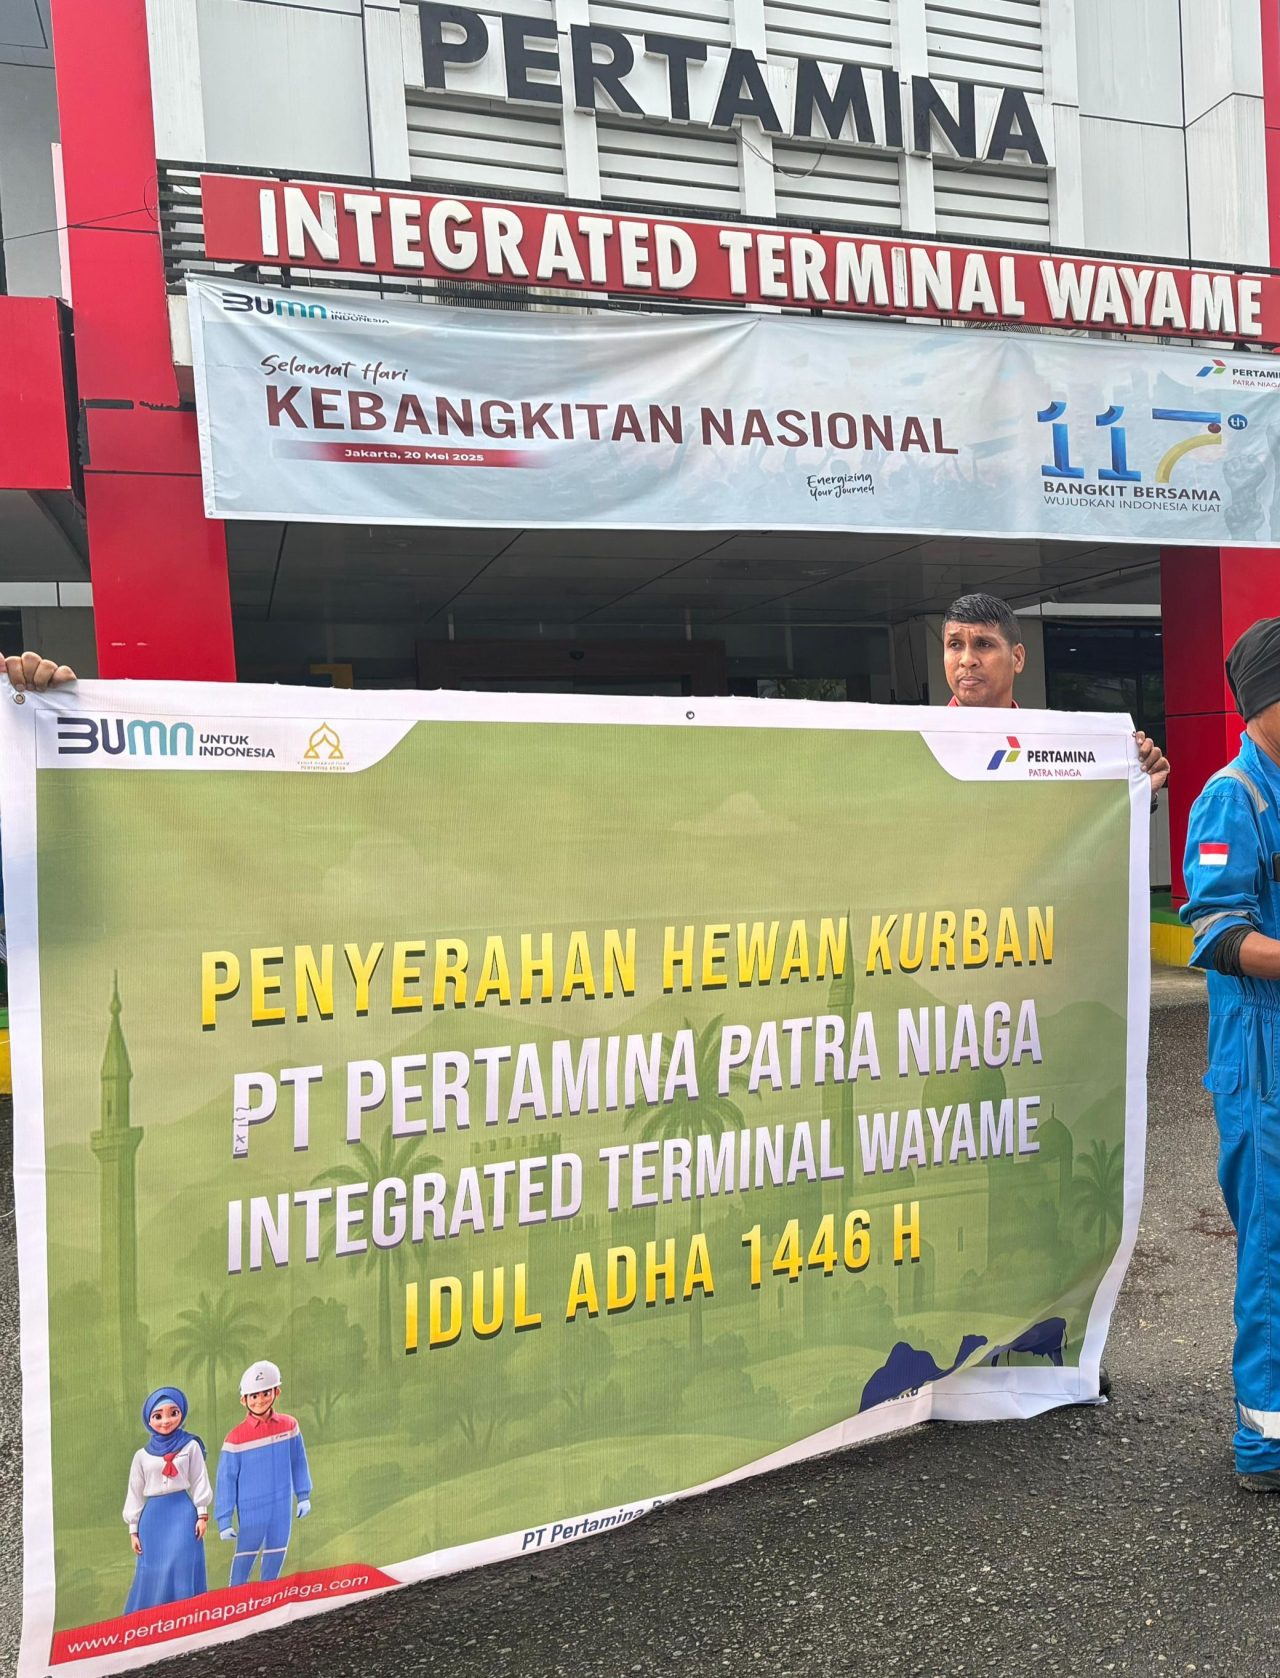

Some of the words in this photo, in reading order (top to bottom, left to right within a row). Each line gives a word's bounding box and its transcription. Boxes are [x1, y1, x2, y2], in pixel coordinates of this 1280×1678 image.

[419, 1, 1048, 165] PERTAMINA
[259, 186, 698, 291] INTEGRATED
[718, 229, 1026, 317] TERMINAL
[1039, 259, 1263, 336] WAYAME
[260, 354, 357, 379] Selamat
[361, 361, 409, 385] Hari
[1232, 378, 1255, 387] PATRA
[265, 384, 683, 444] KEBANGKITAN
[700, 406, 959, 455] NASIONAL
[344, 448, 401, 461] Jakarta,
[404, 450, 422, 460] 20
[452, 452, 485, 462] 2025
[806, 473, 873, 489] Energizing
[834, 485, 875, 499] Journey
[1044, 481, 1127, 497] BANGKIT
[1133, 486, 1221, 502] BERSAMA
[1044, 495, 1115, 508] WUJUDKAN
[1119, 500, 1188, 511] INDONESIA
[1192, 504, 1222, 513] KUAT
[199, 734, 249, 746] UNTUK
[199, 746, 276, 758] INDONESIA
[1027, 750, 1096, 763] PERTAMINA
[1028, 768, 1053, 777] PATRA
[1055, 769, 1082, 777] NIAGA
[201, 928, 637, 1031] PENYERAHAN
[663, 917, 848, 994] HEWAN
[865, 905, 1055, 977] KURBAN
[232, 1064, 323, 1159] PT
[346, 1028, 699, 1145] PERTAMINA
[717, 1011, 881, 1098] PATRA
[897, 999, 1043, 1078] NIAGA
[228, 1152, 583, 1275] INTEGRATED
[599, 1118, 845, 1212] TERMINAL
[857, 1095, 1041, 1176] WAYAME
[405, 1262, 542, 1355] IDUL
[566, 1232, 714, 1323] ADHA
[741, 1208, 871, 1290] 1446
[893, 1201, 921, 1266] H
[522, 1527, 547, 1551] PT
[67, 1573, 369, 1655] www.pertaminapatraniaga.com
